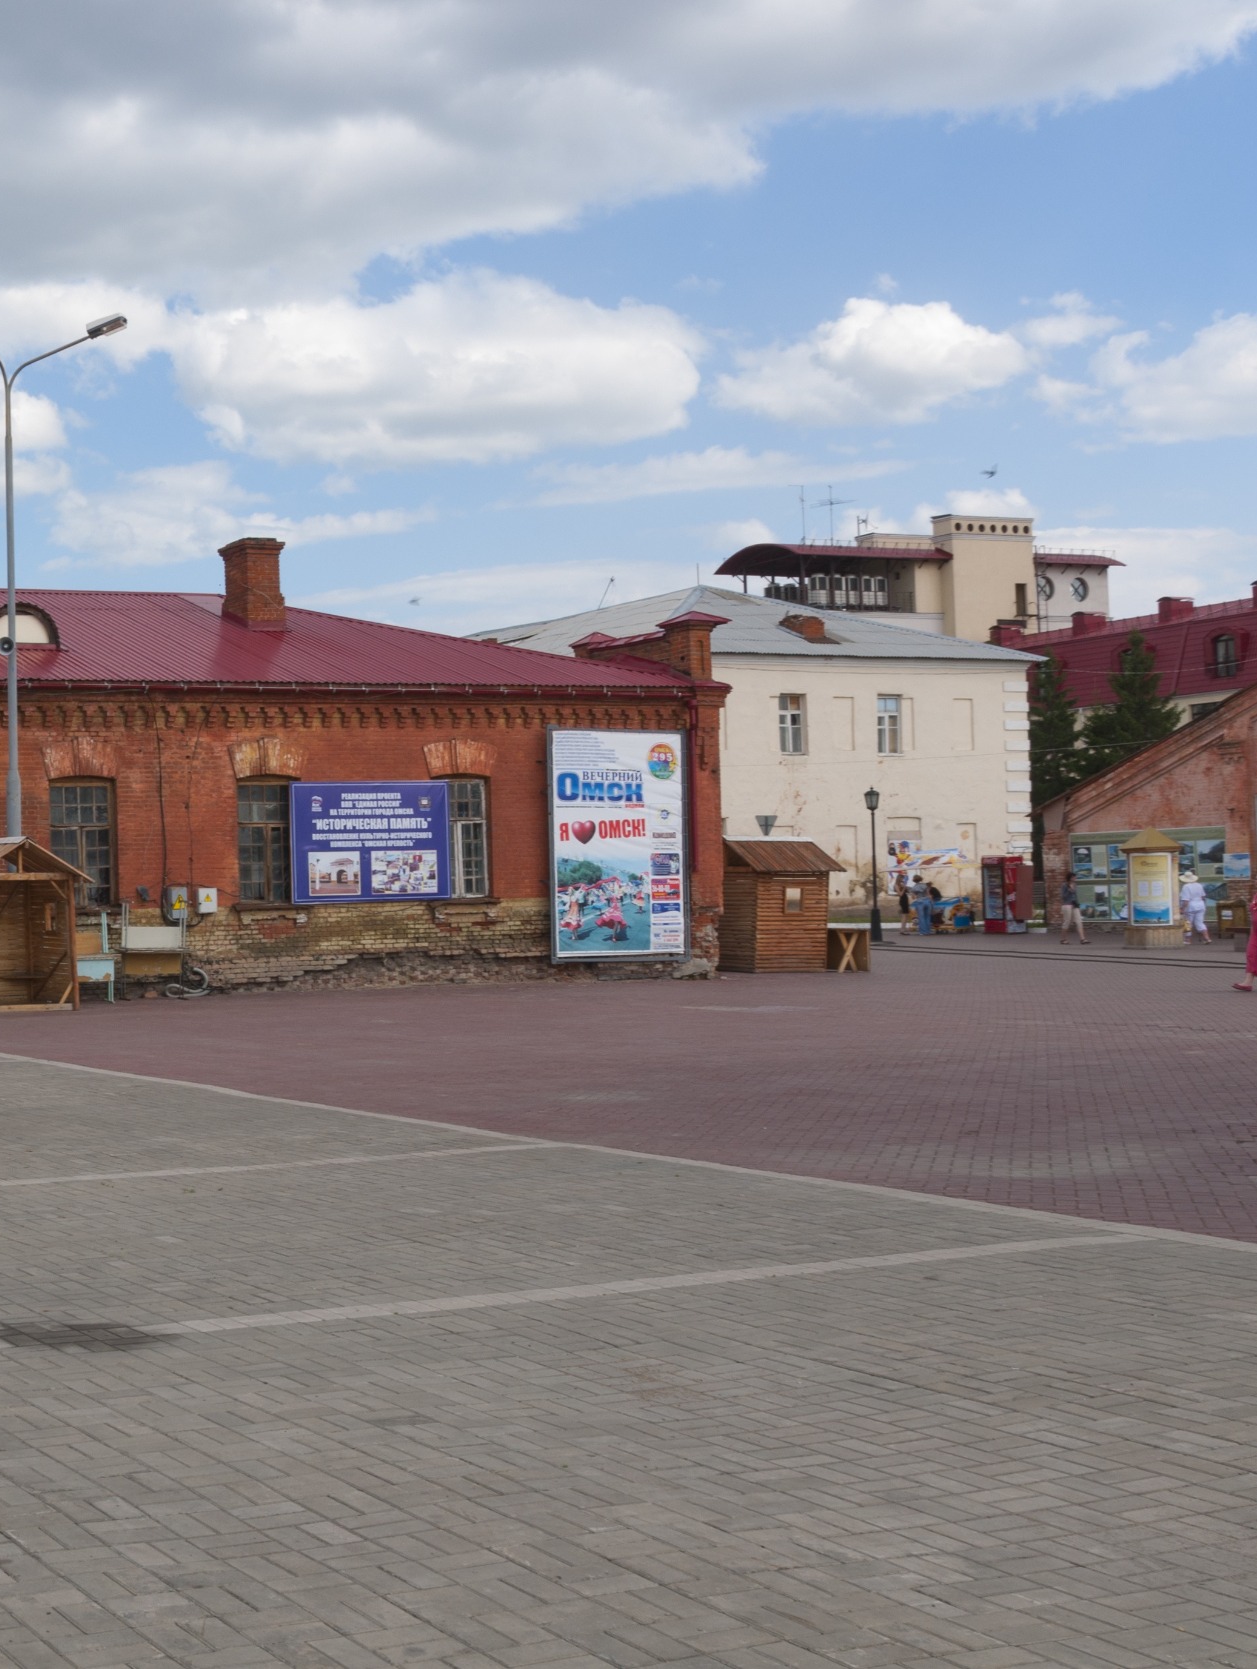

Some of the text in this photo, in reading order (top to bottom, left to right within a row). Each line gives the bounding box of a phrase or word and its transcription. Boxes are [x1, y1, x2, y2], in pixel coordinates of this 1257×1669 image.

[652, 753, 673, 762] 295
[582, 770, 642, 782] ВЕЧЕРНИЙ
[372, 808, 394, 816] ГОРОДА
[312, 818, 432, 830] "ИСТОРИЧЕСКАЯ ПАМЯТЬ"
[559, 818, 646, 841] Я ОМСК!
